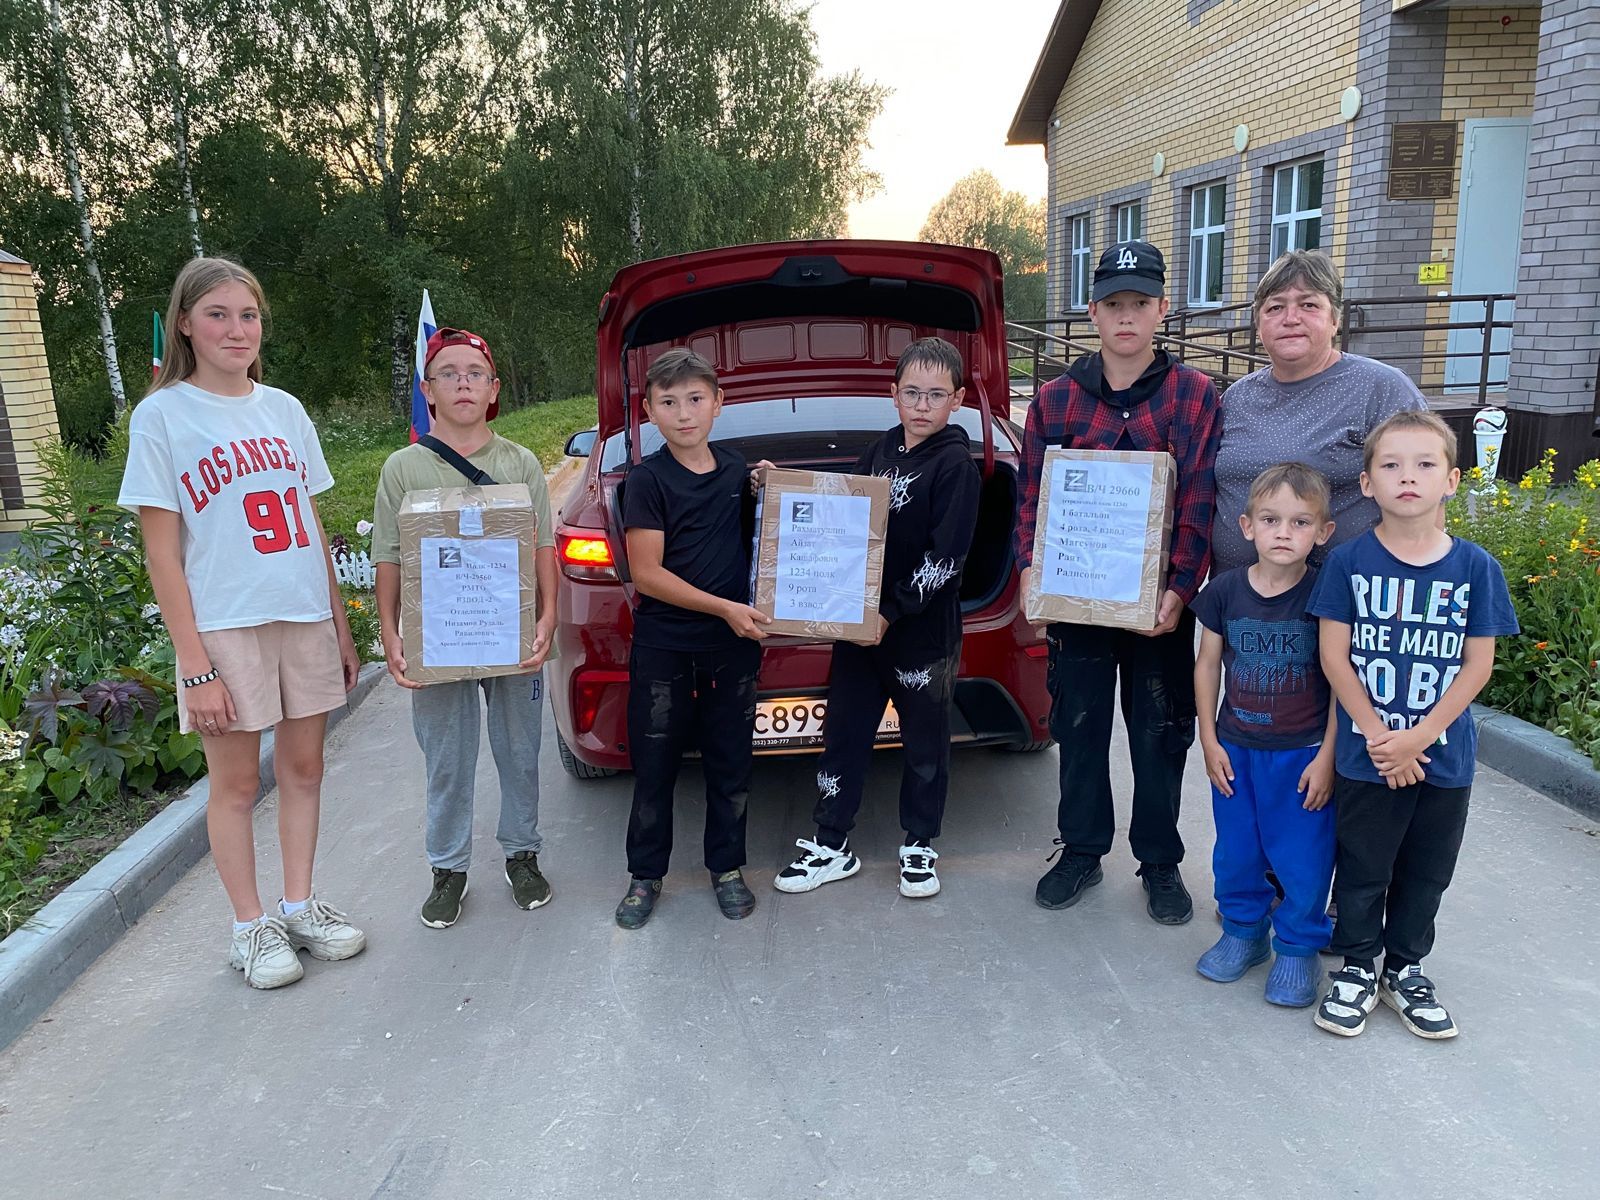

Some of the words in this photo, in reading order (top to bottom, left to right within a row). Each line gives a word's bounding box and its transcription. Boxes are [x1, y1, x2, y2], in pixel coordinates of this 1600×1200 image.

[1116, 247, 1138, 270] LA
[180, 445, 233, 514] LOS
[1087, 484, 1106, 494] В/Ч
[1109, 486, 1140, 497] 29660
[242, 486, 310, 555] 91
[791, 524, 846, 535] Рахматуллин
[789, 567, 811, 577] 1234
[813, 570, 836, 578] полк
[788, 584, 794, 592] 9
[796, 586, 817, 595] рота
[790, 599, 795, 608] 3
[798, 601, 824, 610] взвод
[1351, 574, 1470, 626] RULES
[1240, 631, 1301, 654] CMK
[1351, 622, 1392, 651] ARE
[885, 720, 900, 729] RU
